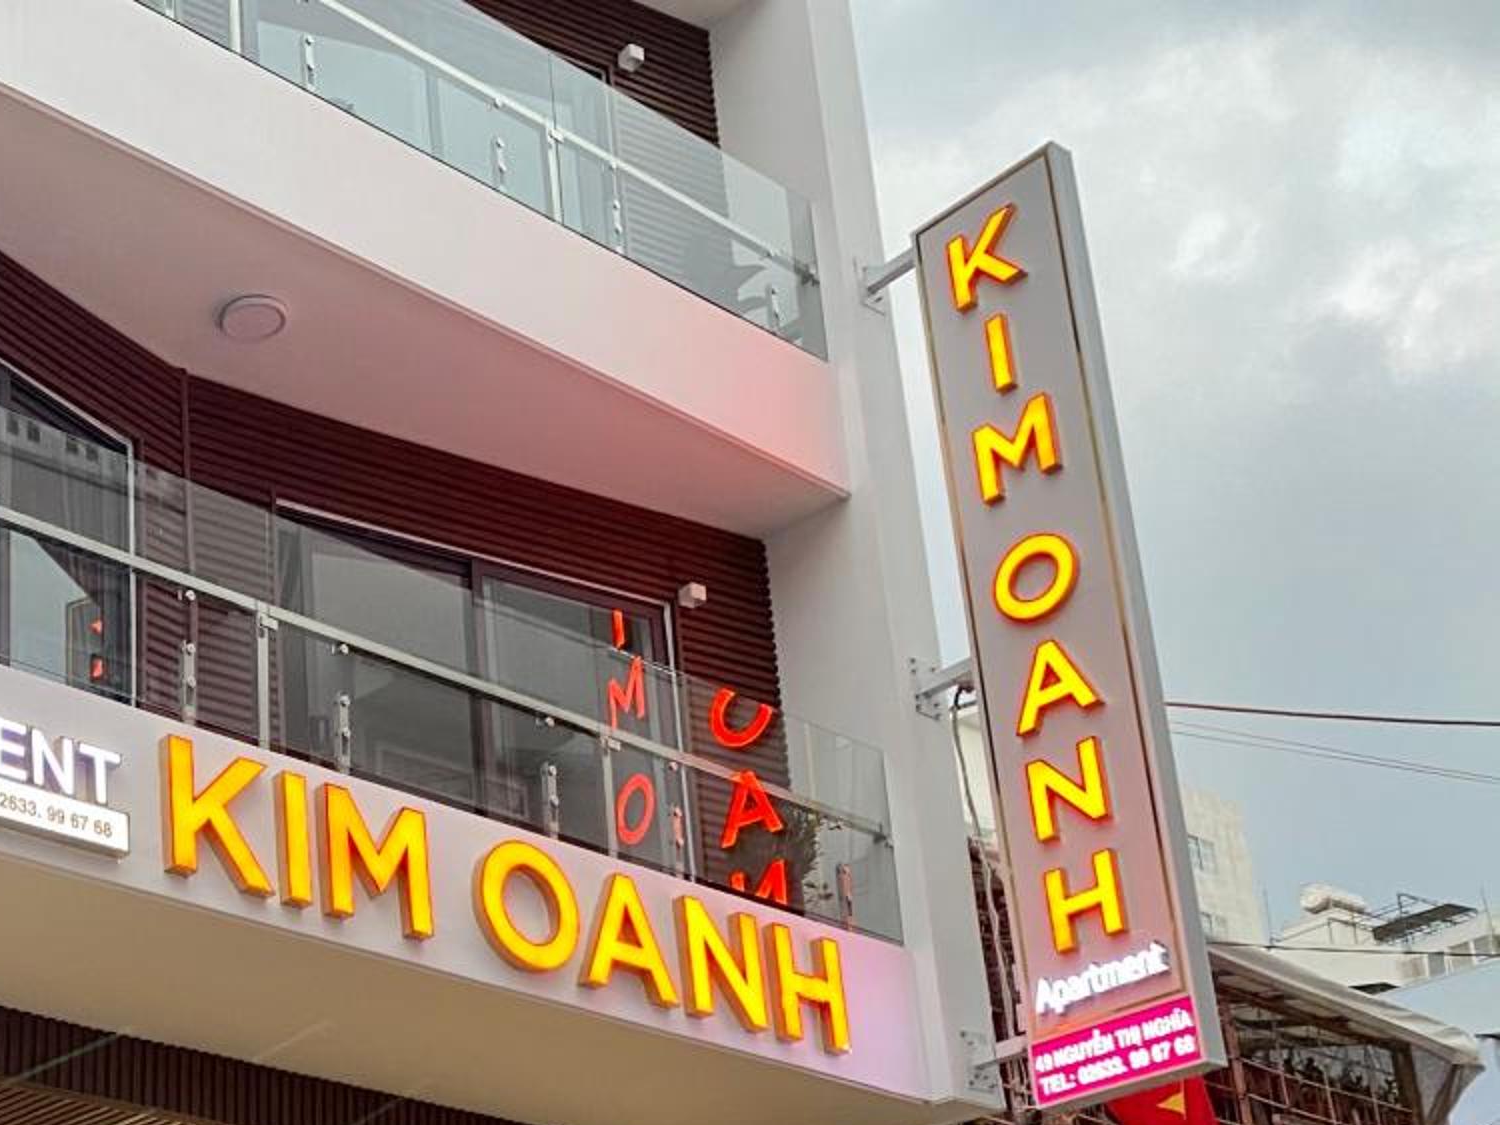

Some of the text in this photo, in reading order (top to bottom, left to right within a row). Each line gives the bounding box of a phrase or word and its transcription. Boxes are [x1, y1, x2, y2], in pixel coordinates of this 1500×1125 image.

[947, 203, 1129, 954] KIM OANH
[46, 804, 66, 825] 99
[160, 734, 851, 1054] KIM OANH
[1036, 942, 1170, 1013] Apartment
